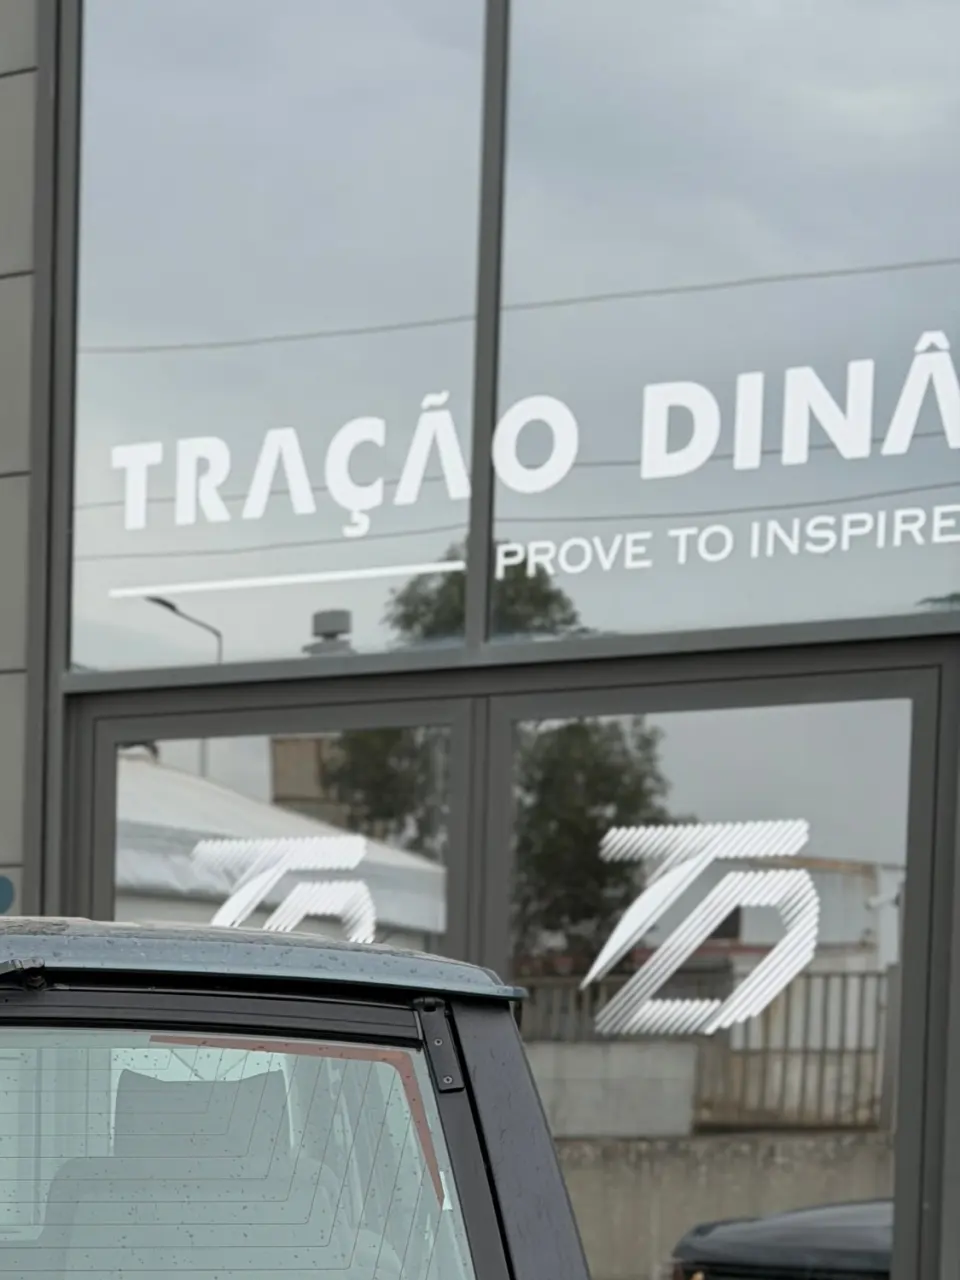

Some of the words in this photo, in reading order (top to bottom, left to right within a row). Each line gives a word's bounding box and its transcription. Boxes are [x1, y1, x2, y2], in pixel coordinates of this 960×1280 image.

[111, 391, 579, 537] TRAÇÃO
[495, 531, 653, 580] PROVE
[667, 524, 734, 565] TO
[750, 504, 960, 559] INSPIRE
